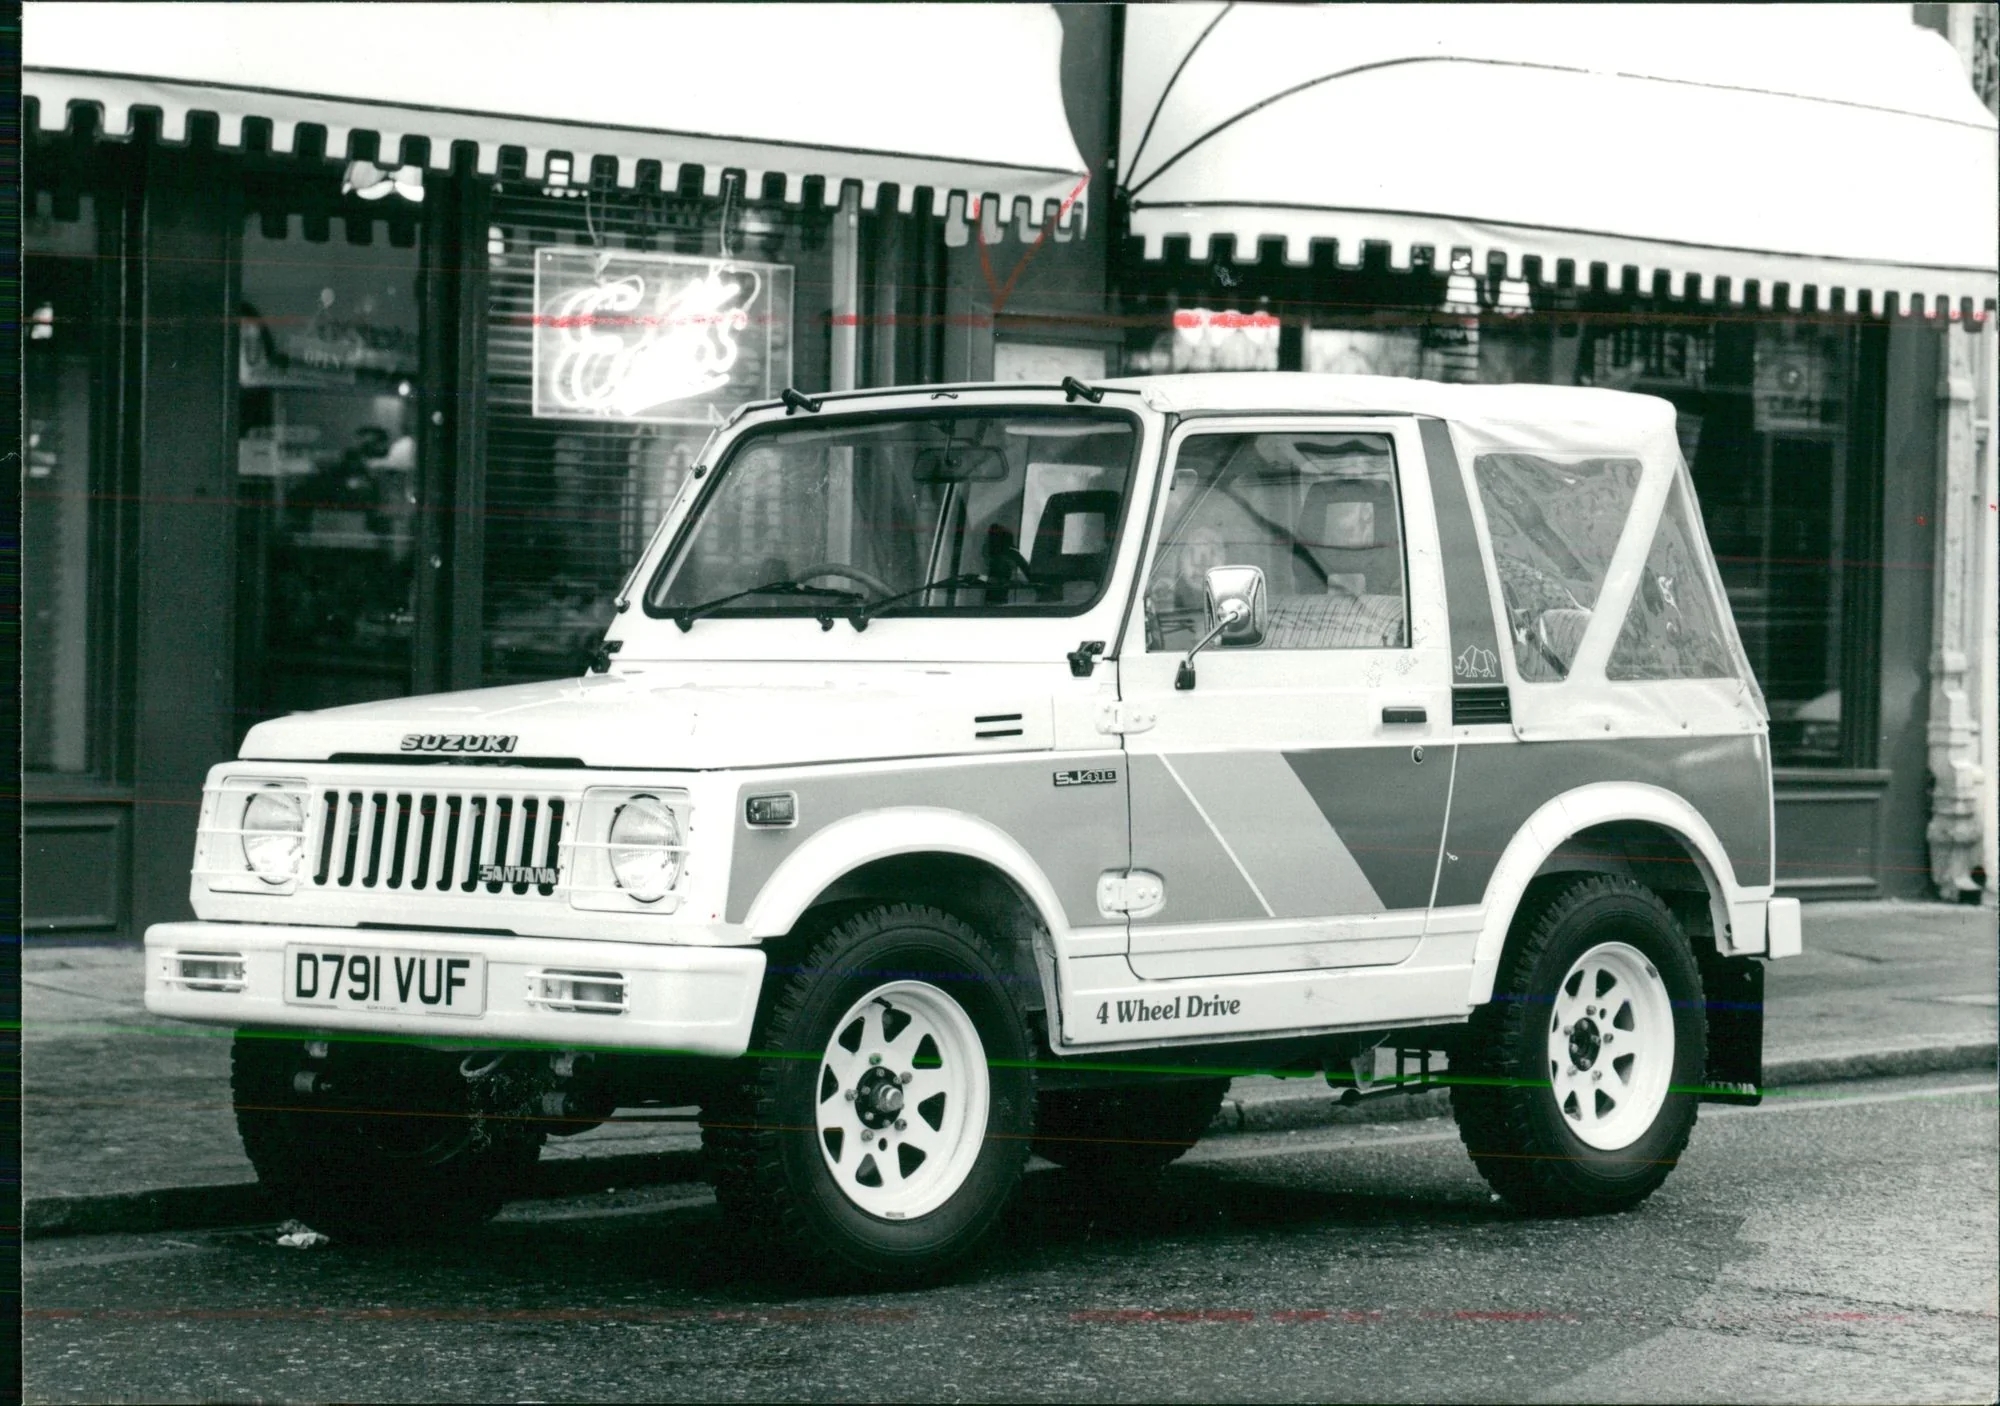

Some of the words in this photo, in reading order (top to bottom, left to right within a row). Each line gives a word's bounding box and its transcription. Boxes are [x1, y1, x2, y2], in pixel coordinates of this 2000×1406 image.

[400, 734, 518, 752] SUZUKI
[479, 865, 558, 884] SANTANA
[296, 952, 380, 1001] D791
[394, 956, 470, 1006] VUF
[1096, 1001, 1109, 1025] 4
[1116, 996, 1181, 1023] Wheel
[1186, 994, 1241, 1018] Drive
